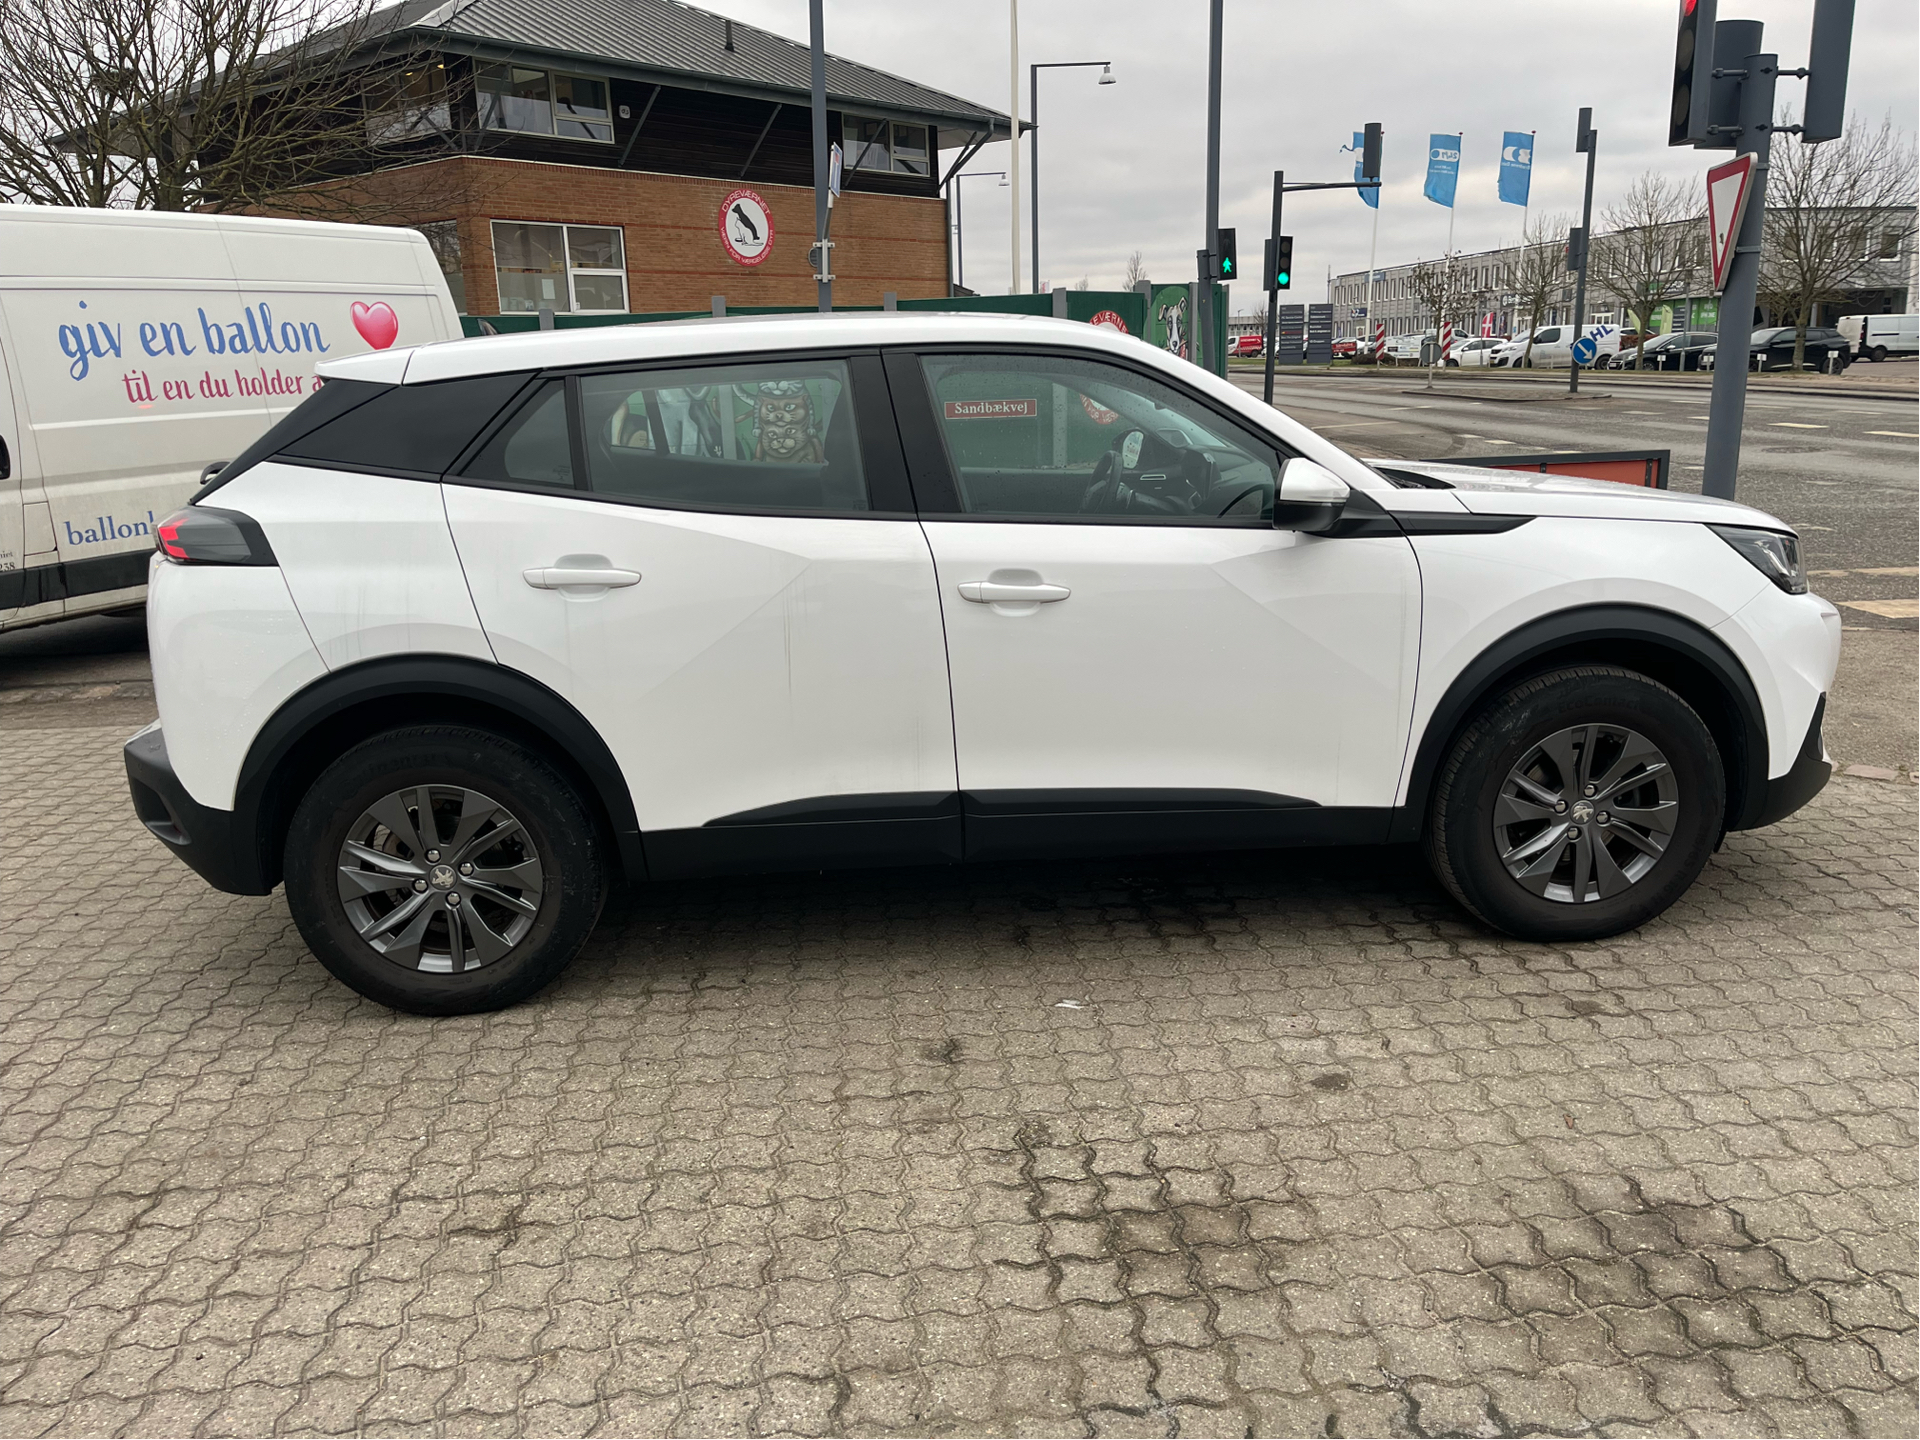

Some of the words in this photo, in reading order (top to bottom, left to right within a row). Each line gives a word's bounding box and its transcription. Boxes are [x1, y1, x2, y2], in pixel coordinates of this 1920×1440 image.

[722, 190, 771, 215] DYREVÆRNET
[729, 249, 741, 261] FOR
[58, 300, 122, 381] giv
[139, 316, 196, 356] en
[197, 302, 331, 356] ballon
[121, 369, 158, 403] til
[163, 378, 195, 400] en
[200, 371, 234, 398] du
[234, 366, 303, 397] holder
[311, 375, 325, 394] a
[954, 401, 1028, 415] Sandbækvej
